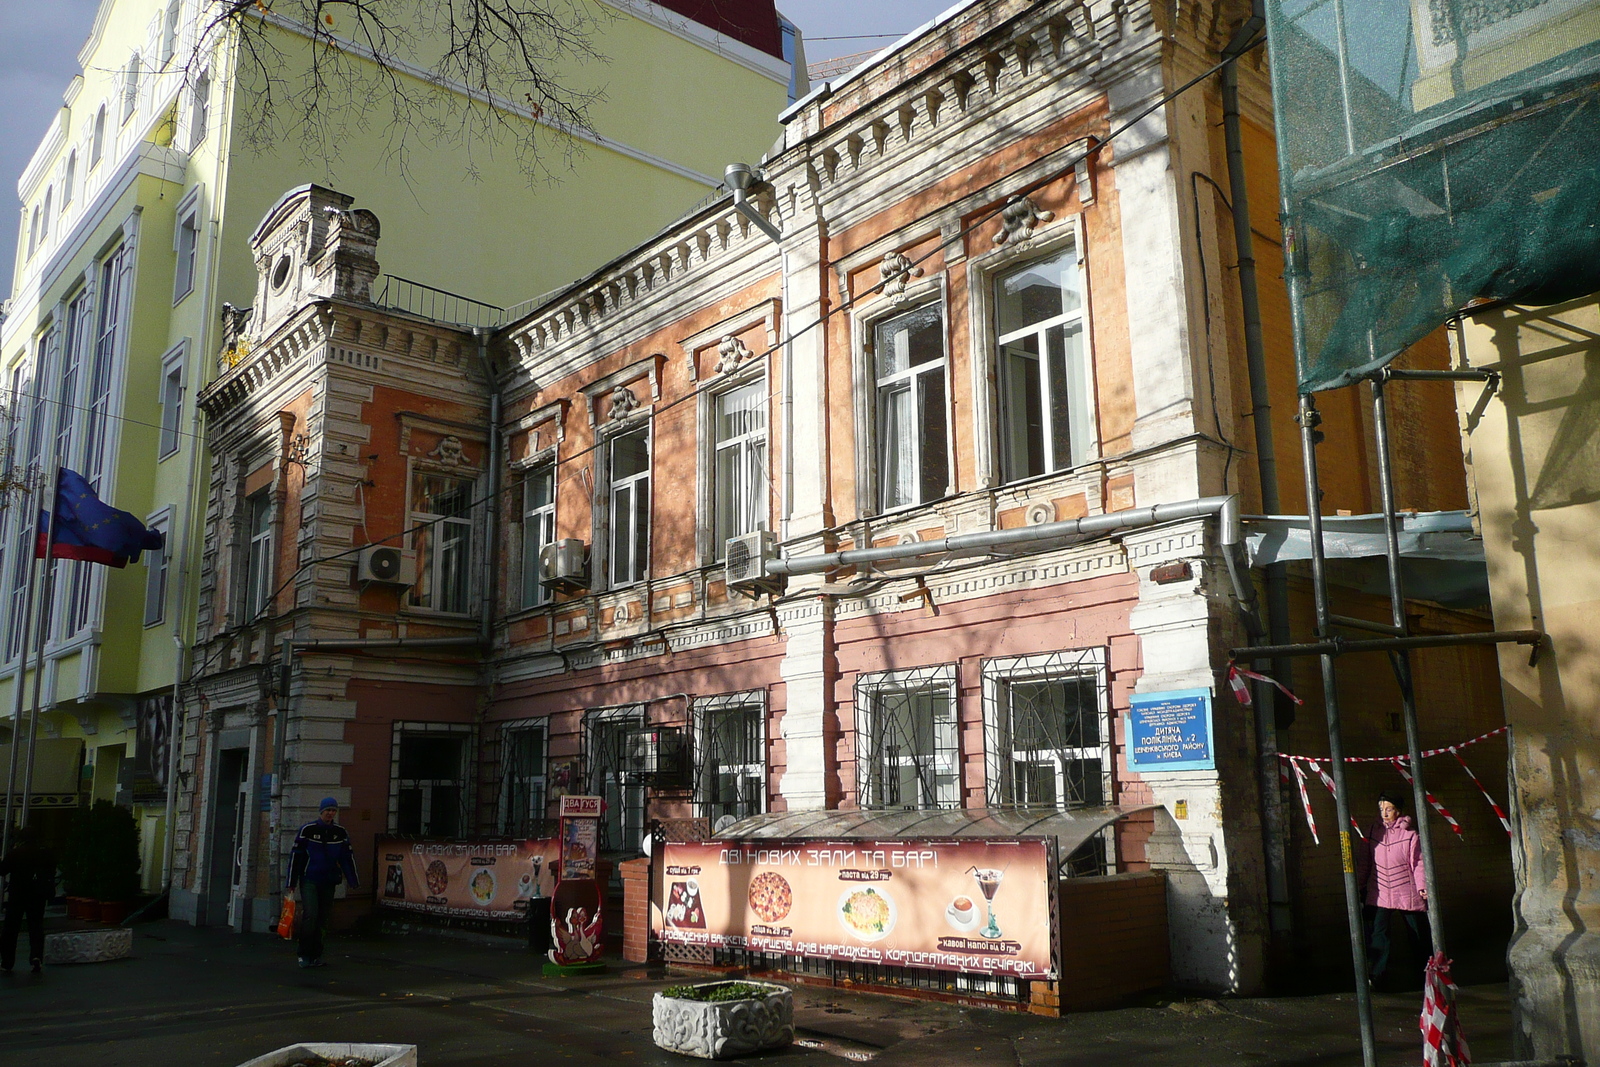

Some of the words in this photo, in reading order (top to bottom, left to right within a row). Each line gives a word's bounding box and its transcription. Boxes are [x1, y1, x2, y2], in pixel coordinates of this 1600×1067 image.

[1155, 727, 1181, 736] ДИТЯЧА
[1141, 735, 1182, 745] ПОЛІКЛІНІКА
[565, 799, 579, 808] ДВА
[719, 850, 742, 865] ДВІ
[747, 850, 801, 865] НОВИХ
[807, 850, 856, 866] ЗАЛИ
[862, 850, 886, 867] ТА
[891, 851, 938, 868] БАР!
[870, 871, 879, 879] 29
[943, 939, 965, 948] кавові
[968, 941, 988, 950] напої
[1000, 942, 1006, 951] 8
[796, 942, 817, 953] ДНІВ
[886, 950, 980, 968] КОРПОРАТИВНИХ
